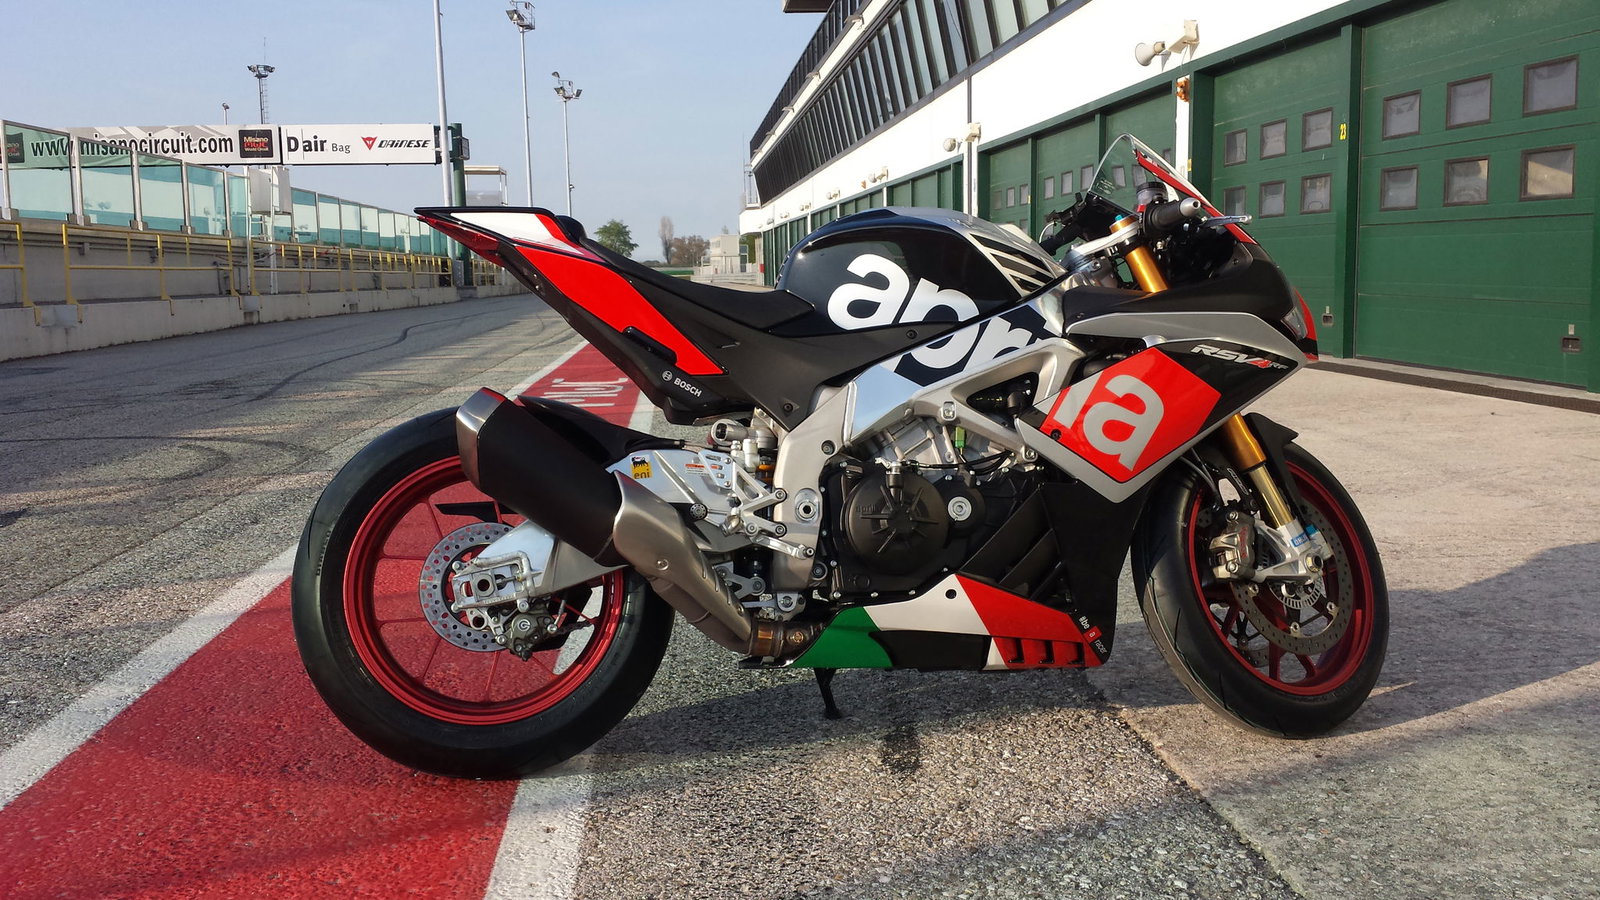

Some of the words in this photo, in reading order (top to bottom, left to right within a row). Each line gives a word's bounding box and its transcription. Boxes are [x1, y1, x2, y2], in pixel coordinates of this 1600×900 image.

[331, 143, 351, 154] Bag
[674, 377, 702, 397] BOSCH
[633, 468, 651, 480] eni
